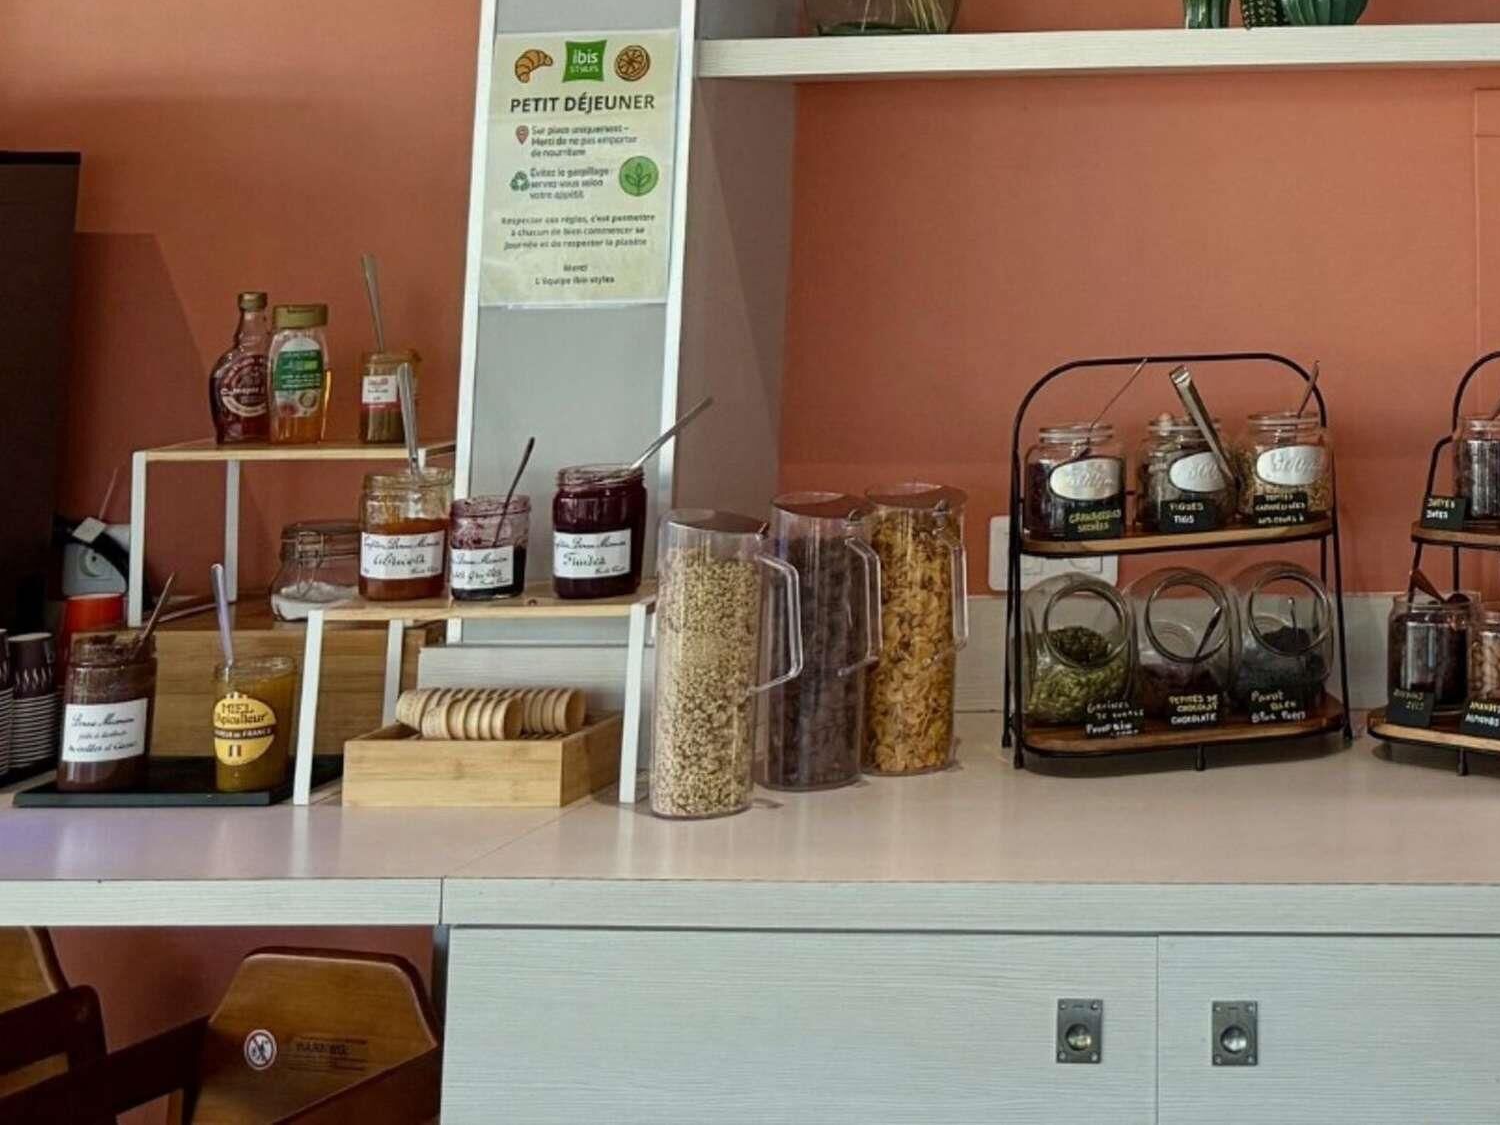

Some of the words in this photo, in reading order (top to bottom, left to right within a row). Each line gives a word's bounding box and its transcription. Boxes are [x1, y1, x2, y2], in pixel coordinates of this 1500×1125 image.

[572, 49, 599, 65] ibis
[510, 96, 560, 114] PETIT
[564, 92, 655, 115] DÉJEUNER
[531, 126, 546, 135] Sur
[572, 124, 622, 136] uniquement
[531, 137, 555, 146] Merci
[556, 137, 567, 145] de
[580, 138, 596, 147] pas
[597, 136, 638, 146] emporter
[530, 149, 541, 157] de
[543, 149, 586, 157] nourriture
[529, 191, 553, 199] votre
